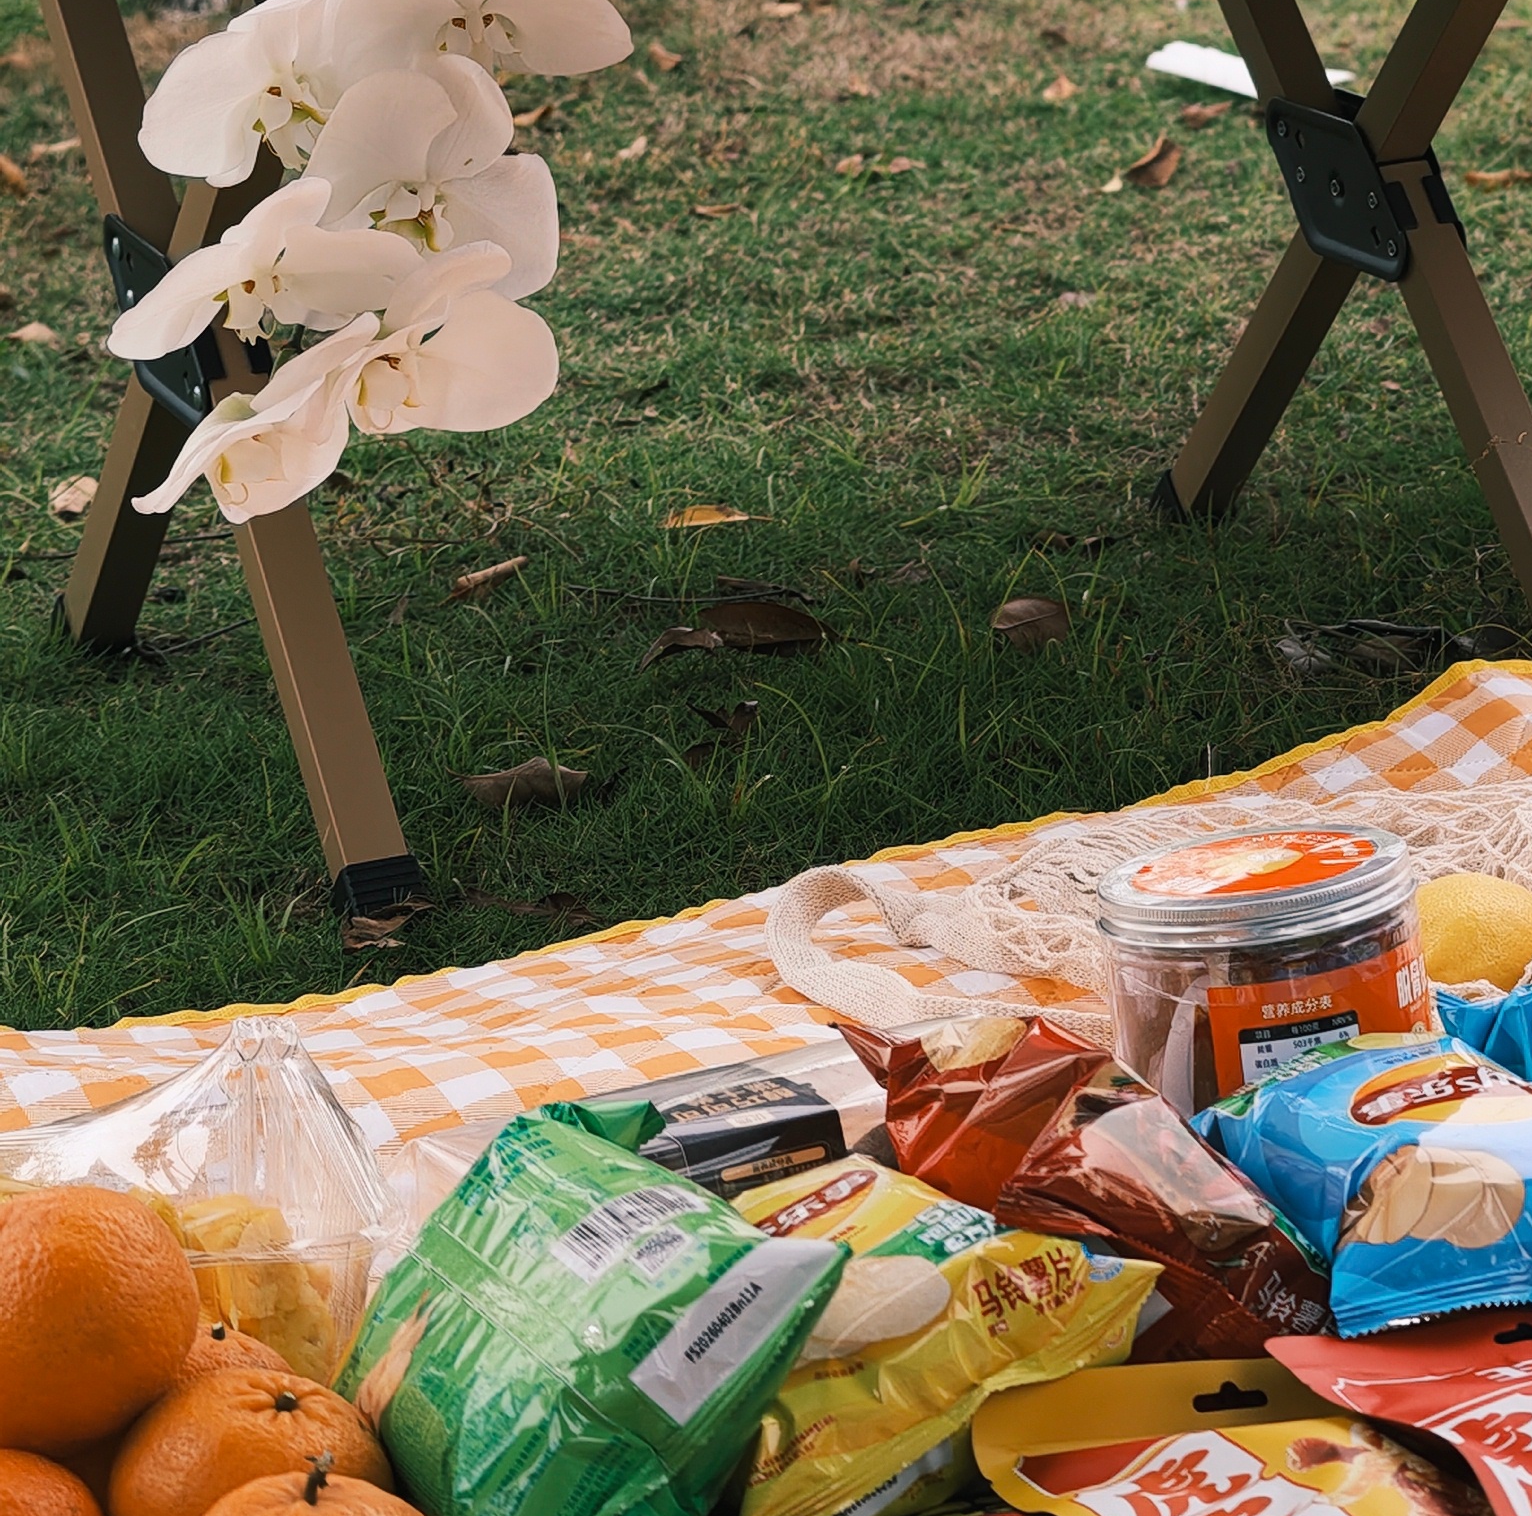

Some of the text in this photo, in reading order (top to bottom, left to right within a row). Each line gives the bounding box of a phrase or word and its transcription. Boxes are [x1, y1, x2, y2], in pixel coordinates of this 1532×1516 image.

[1262, 995, 1333, 1019] 营养成分表
[972, 1247, 1073, 1317] 马铃薯片
